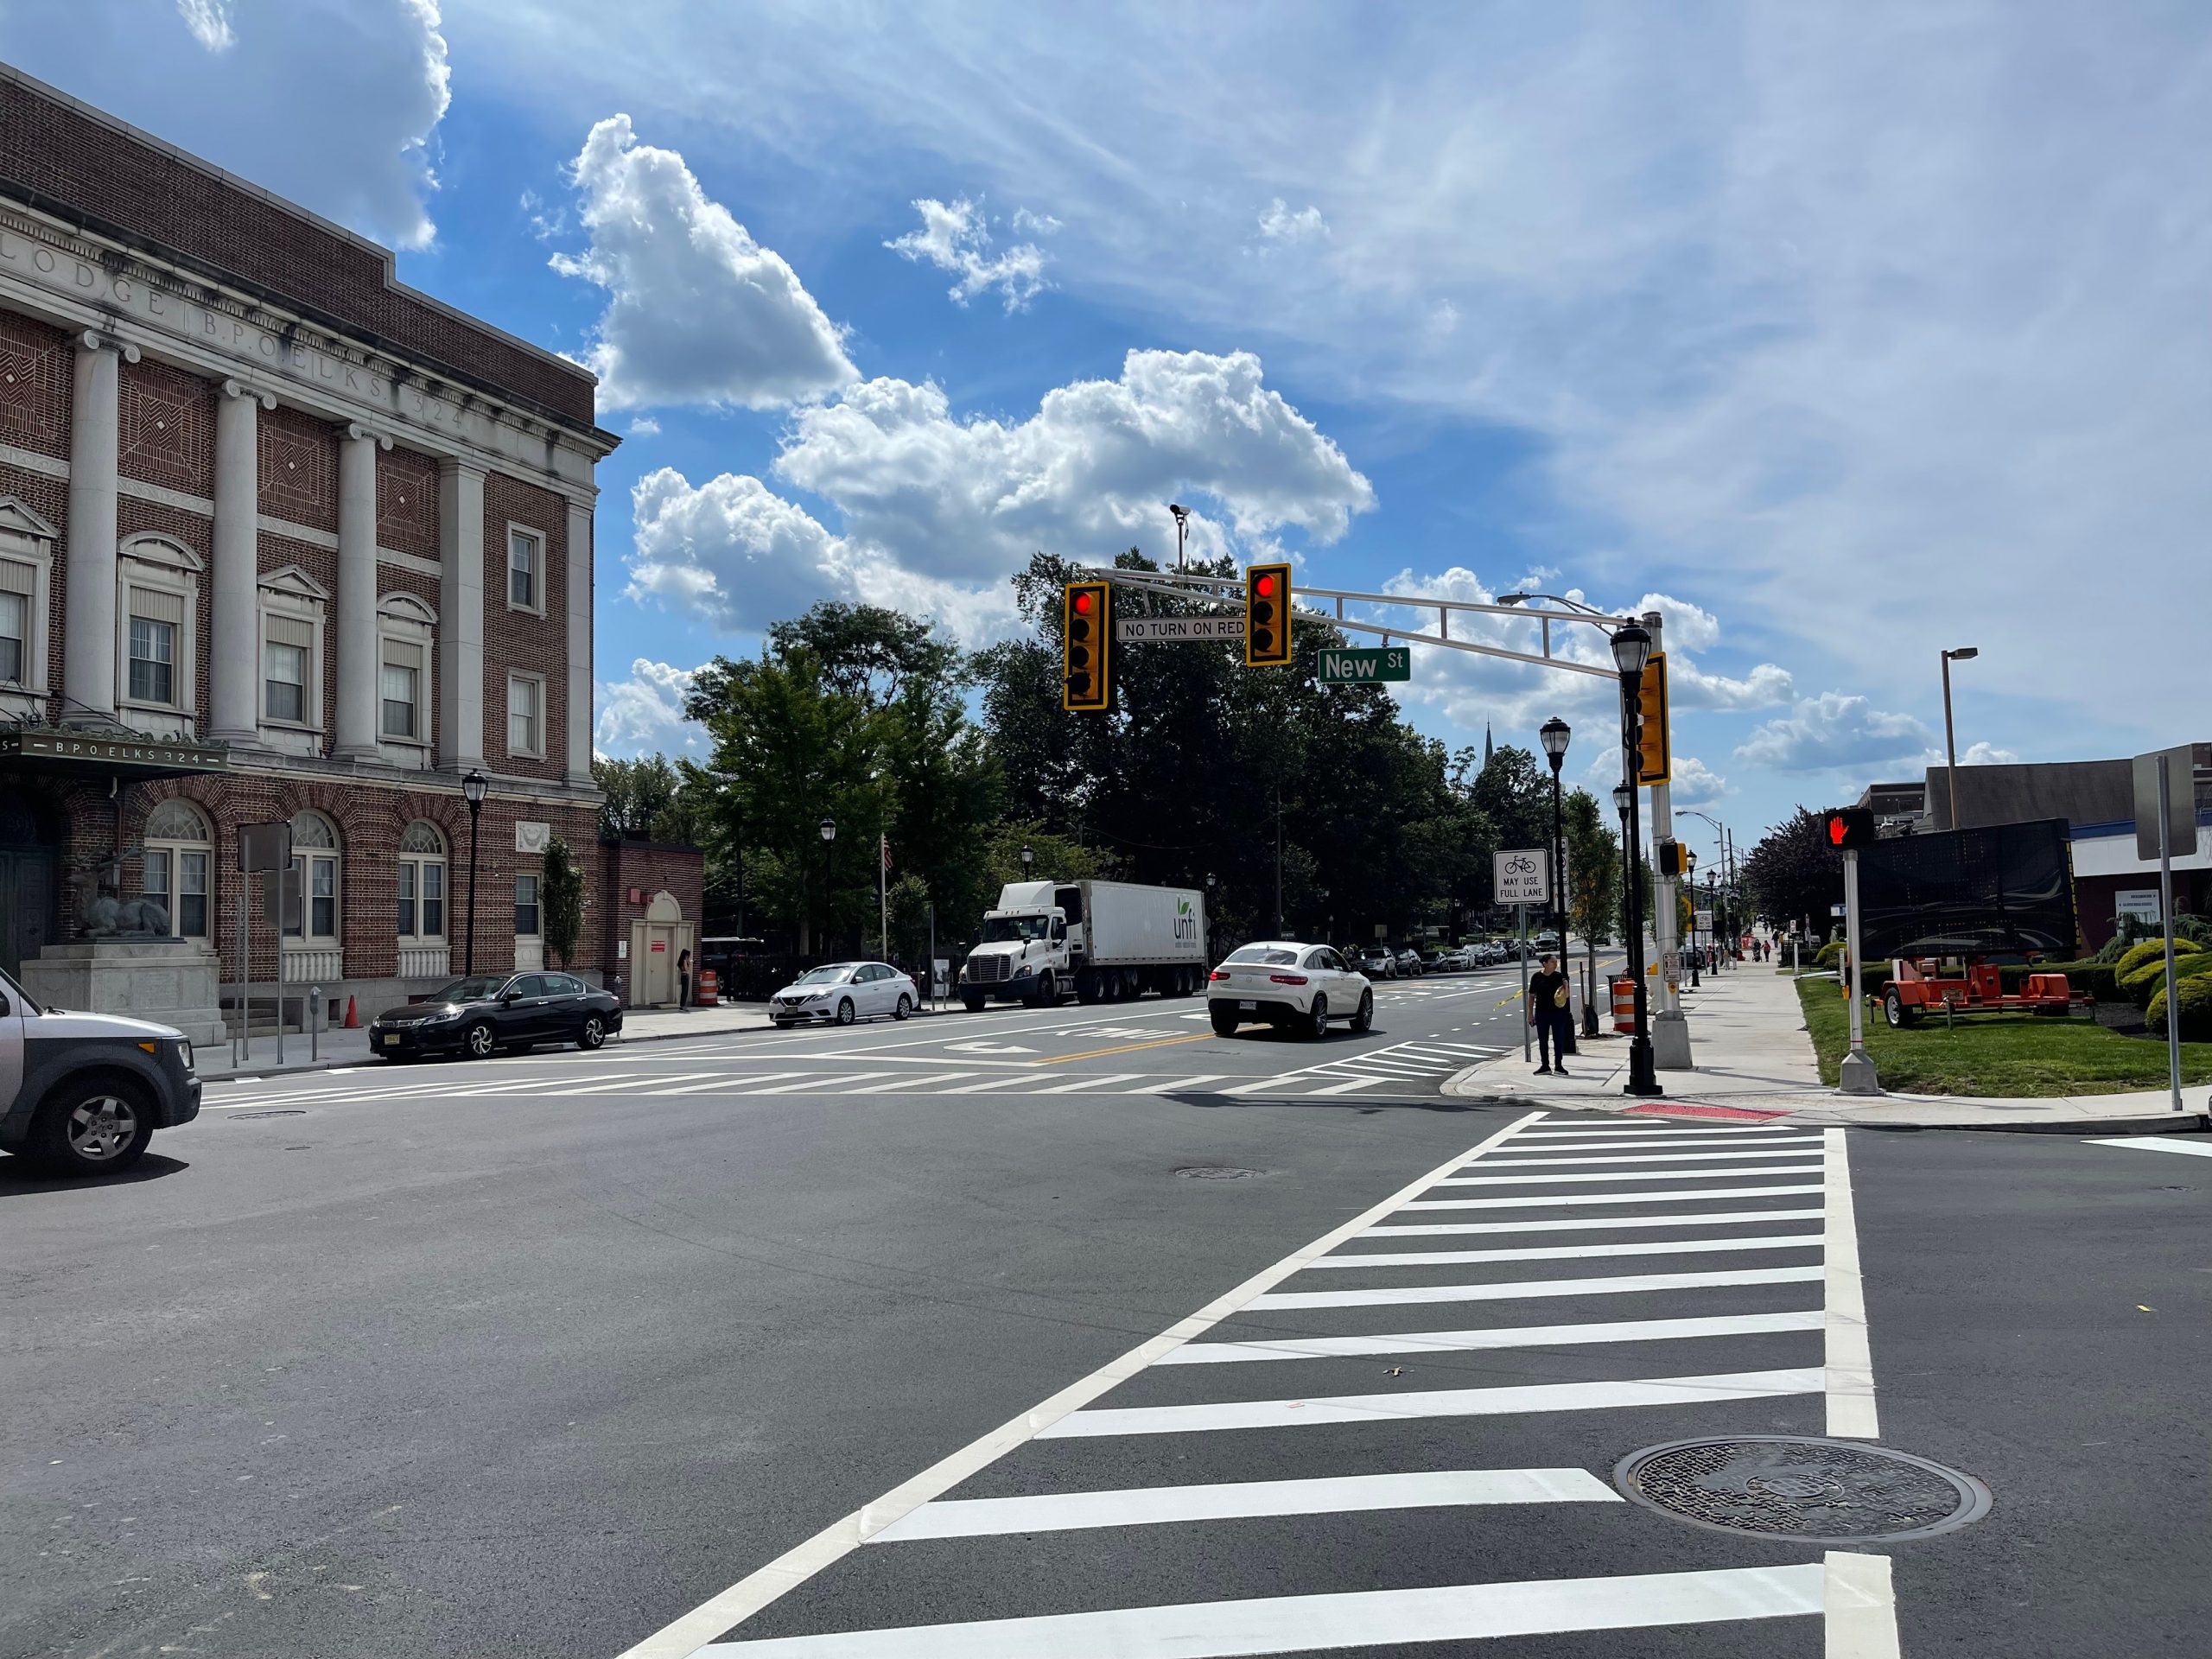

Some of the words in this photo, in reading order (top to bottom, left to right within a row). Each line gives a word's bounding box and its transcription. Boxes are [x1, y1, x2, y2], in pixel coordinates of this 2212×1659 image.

[1125, 622, 1145, 637] NO
[1150, 621, 1187, 636] TURN
[1193, 621, 1212, 635] ON
[1217, 620, 1245, 634] RED
[1325, 653, 1377, 679] New
[1387, 652, 1404, 669] St
[109, 747, 156, 760] ELKS
[165, 752, 200, 764] 324
[1523, 877, 1539, 886] USE
[1500, 889, 1519, 898] FULL
[1523, 888, 1543, 897] LANE
[1173, 908, 1197, 939] unfi
